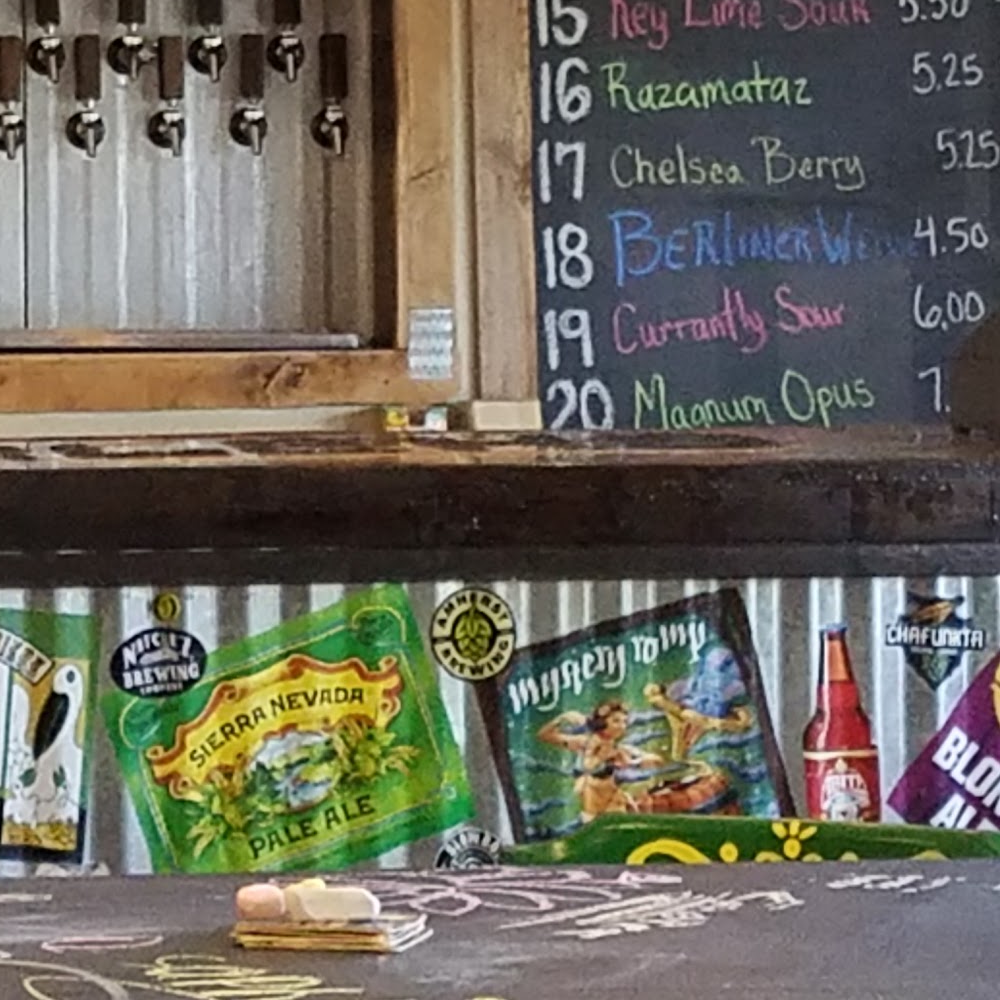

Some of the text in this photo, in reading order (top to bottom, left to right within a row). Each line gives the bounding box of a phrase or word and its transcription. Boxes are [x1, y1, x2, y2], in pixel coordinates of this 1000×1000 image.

[539, 51, 984, 125] 16 Razamataz 5.25
[537, 138, 586, 204] 17
[610, 143, 744, 190] Chelsea
[750, 135, 867, 192] Berry
[542, 221, 594, 290] 18
[913, 214, 990, 258] 4.50
[543, 306, 595, 370] 19
[774, 284, 845, 334] Sour
[912, 284, 986, 332] 6.00
[546, 377, 615, 430] 20
[780, 368, 876, 429] Opus
[440, 640, 510, 676] BREWING
[886, 623, 984, 648] CHAFUNKTA
[122, 662, 200, 690] BREWING
[188, 686, 366, 770] SIERRA NEVADA
[248, 793, 376, 861] PALE ALE
